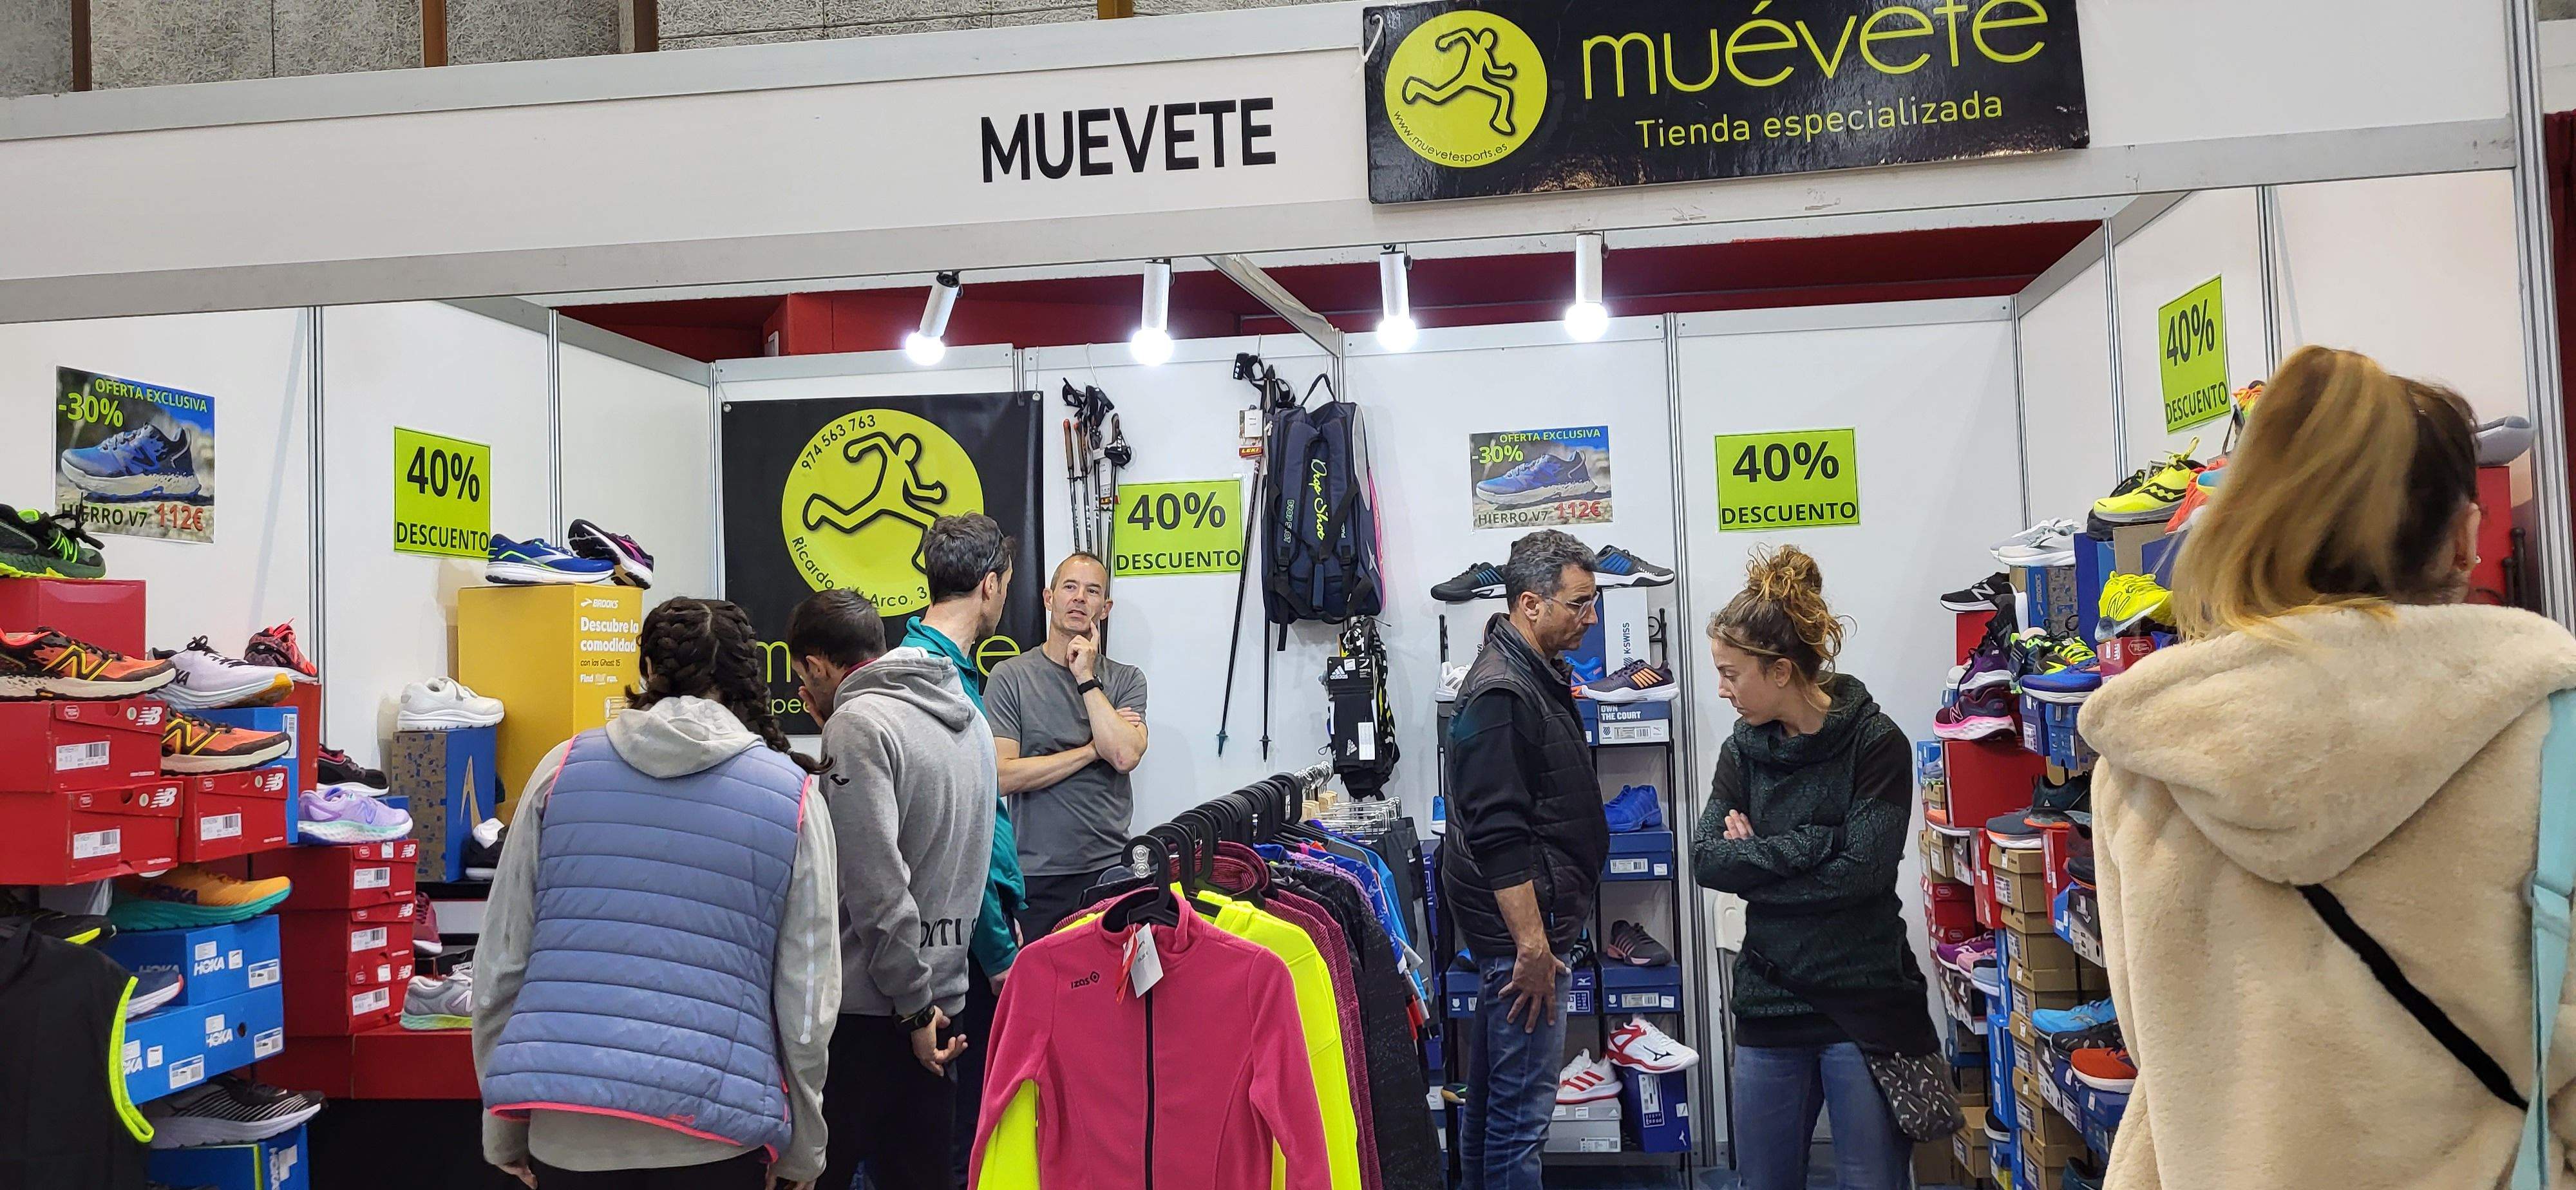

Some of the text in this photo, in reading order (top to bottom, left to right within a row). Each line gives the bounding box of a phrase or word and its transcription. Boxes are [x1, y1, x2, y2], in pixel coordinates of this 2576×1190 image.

[1582, 0, 2049, 100] muévete
[1394, 110, 1508, 164] www.muevetesports.es
[1634, 90, 2003, 149] Tienda especializada
[981, 97, 1276, 184] MUEVETE
[2166, 298, 2215, 367] 40%
[58, 392, 124, 428] -30%
[95, 378, 208, 413] OFERTA EXCLUSIVA
[2165, 381, 2228, 425] DESCUENTO
[801, 415, 876, 470] 974 563 763
[1472, 444, 1524, 464] -30%
[1499, 429, 1601, 444] OFERTA EXCLUSIVA
[406, 446, 480, 502] 40%
[1732, 440, 1840, 483] 40%
[128, 510, 148, 527] V7
[156, 503, 204, 531] 112€
[1127, 491, 1226, 532] 40%
[1285, 499, 1295, 522] DROP
[1477, 500, 1602, 524] HIERRO V7 112€
[1721, 502, 1857, 525] DESCUENTO
[396, 521, 489, 553] DESCUENTO
[791, 536, 834, 590] Ricardo
[916, 586, 927, 600] 3
[1116, 549, 1241, 571] DESCUENTO
[580, 616, 629, 633] Descubre
[580, 638, 636, 652] comodidad
[1617, 711, 1642, 720] COURT
[194, 956, 225, 976] HOKA
